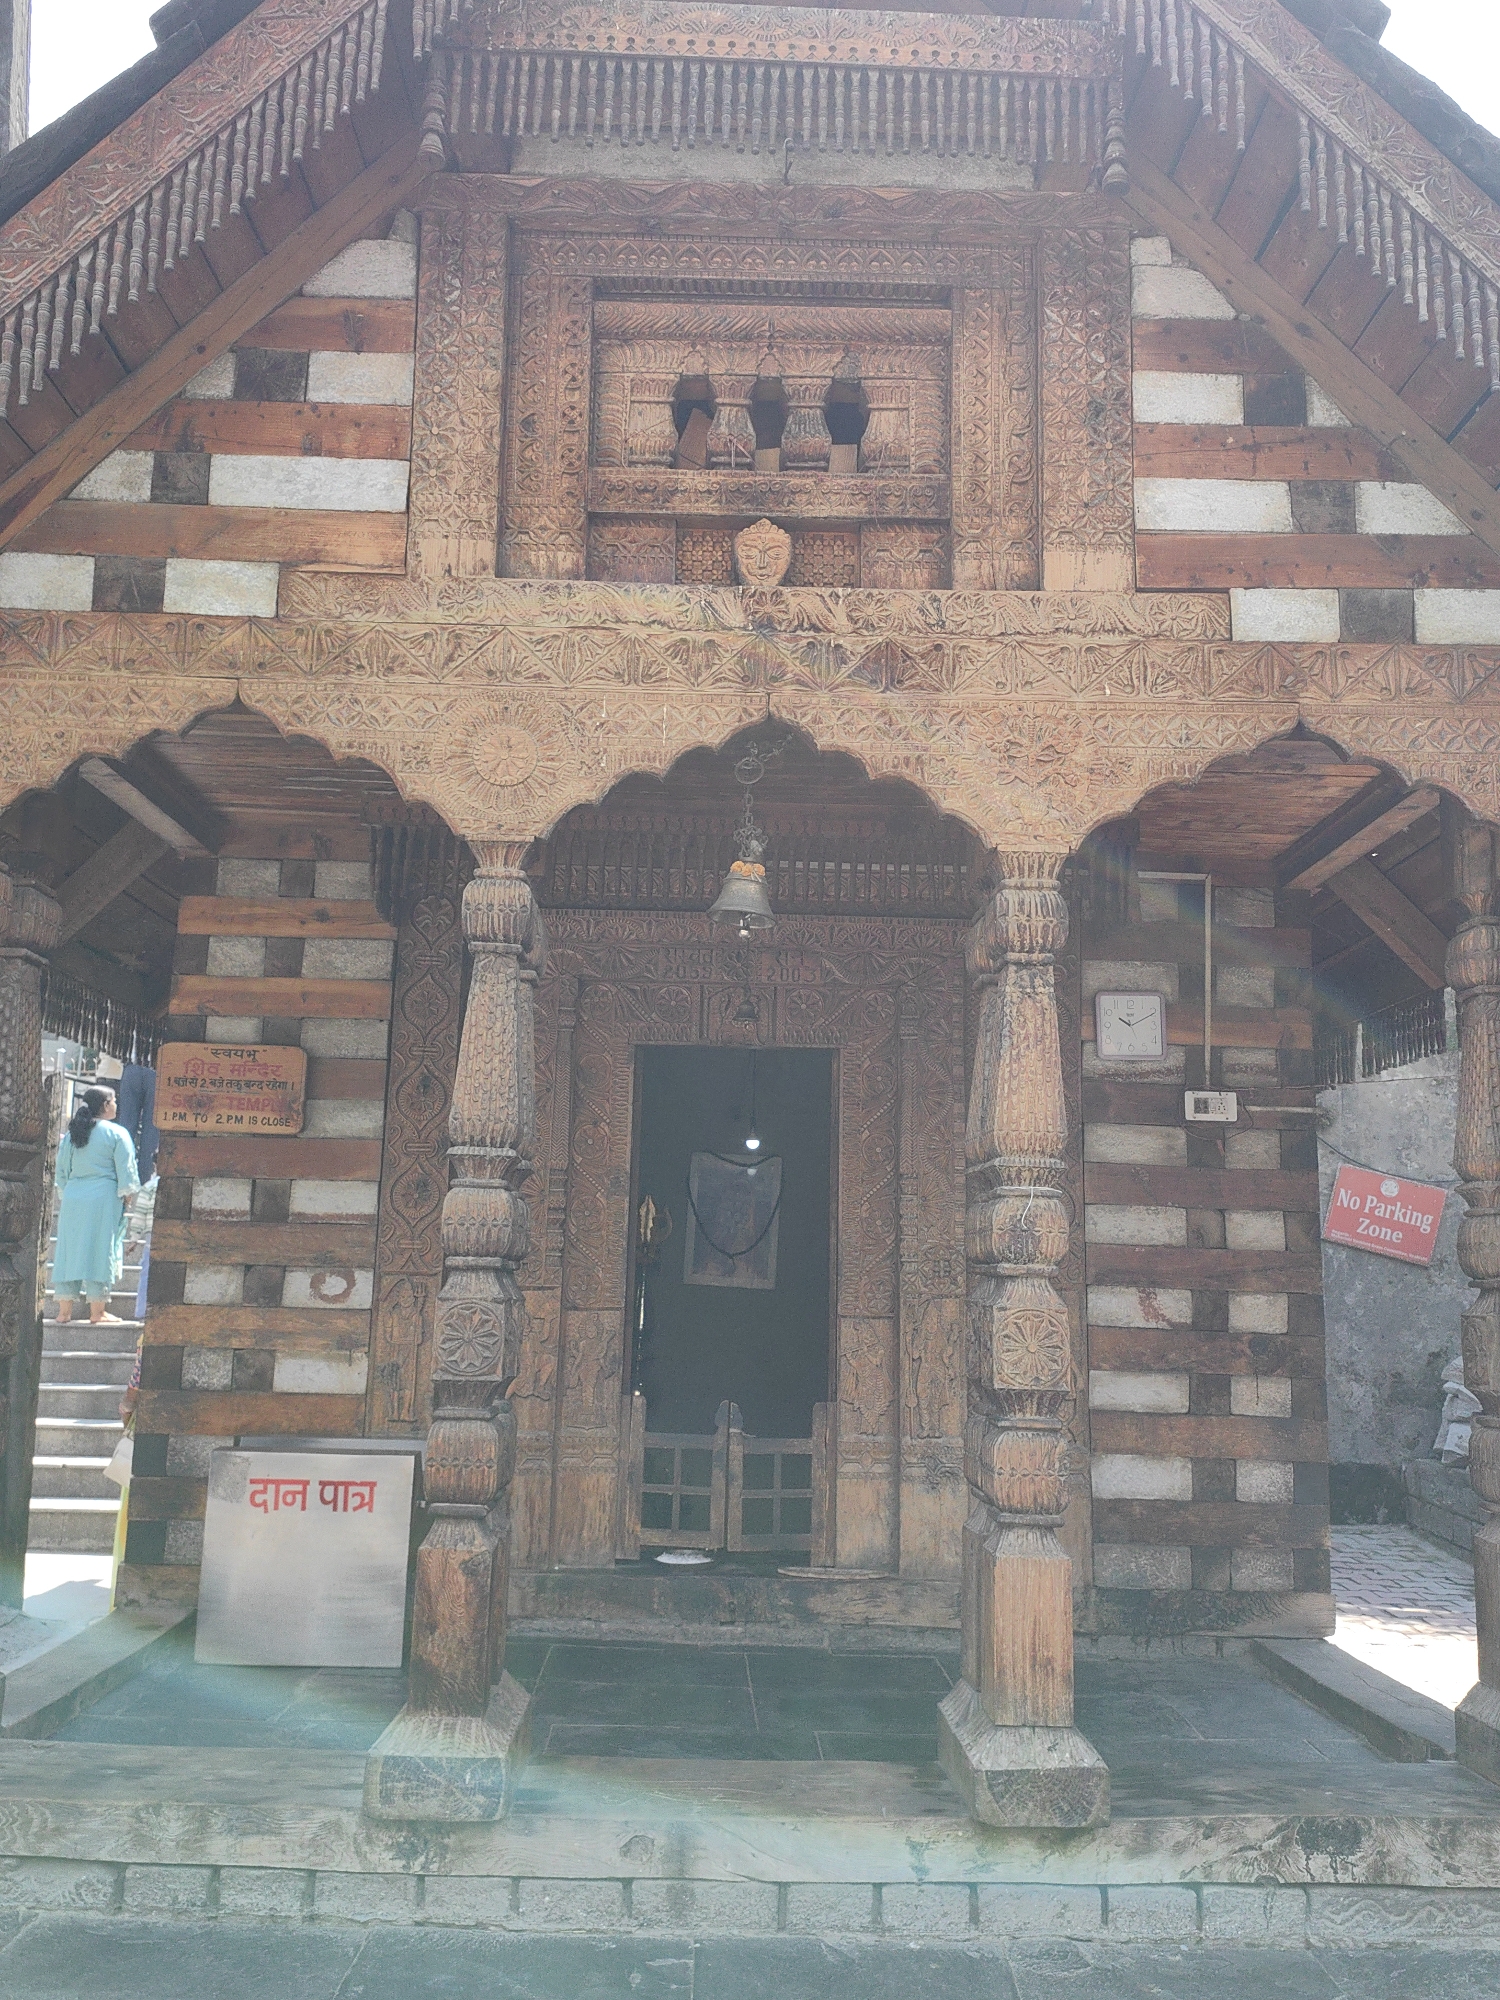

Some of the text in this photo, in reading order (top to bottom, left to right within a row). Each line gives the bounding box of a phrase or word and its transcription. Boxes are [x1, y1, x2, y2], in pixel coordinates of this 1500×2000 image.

[766, 965, 818, 984] 2003
[1103, 1007, 1113, 1017] 10
[1126, 999, 1135, 1010] 12
[184, 1057, 221, 1076] शिव
[193, 1112, 208, 1124] TO
[248, 1115, 258, 1125] IS
[1336, 1188, 1434, 1234] No Parking
[1356, 1217, 1403, 1243] Zone
[249, 1478, 378, 1514] दान पात्र
